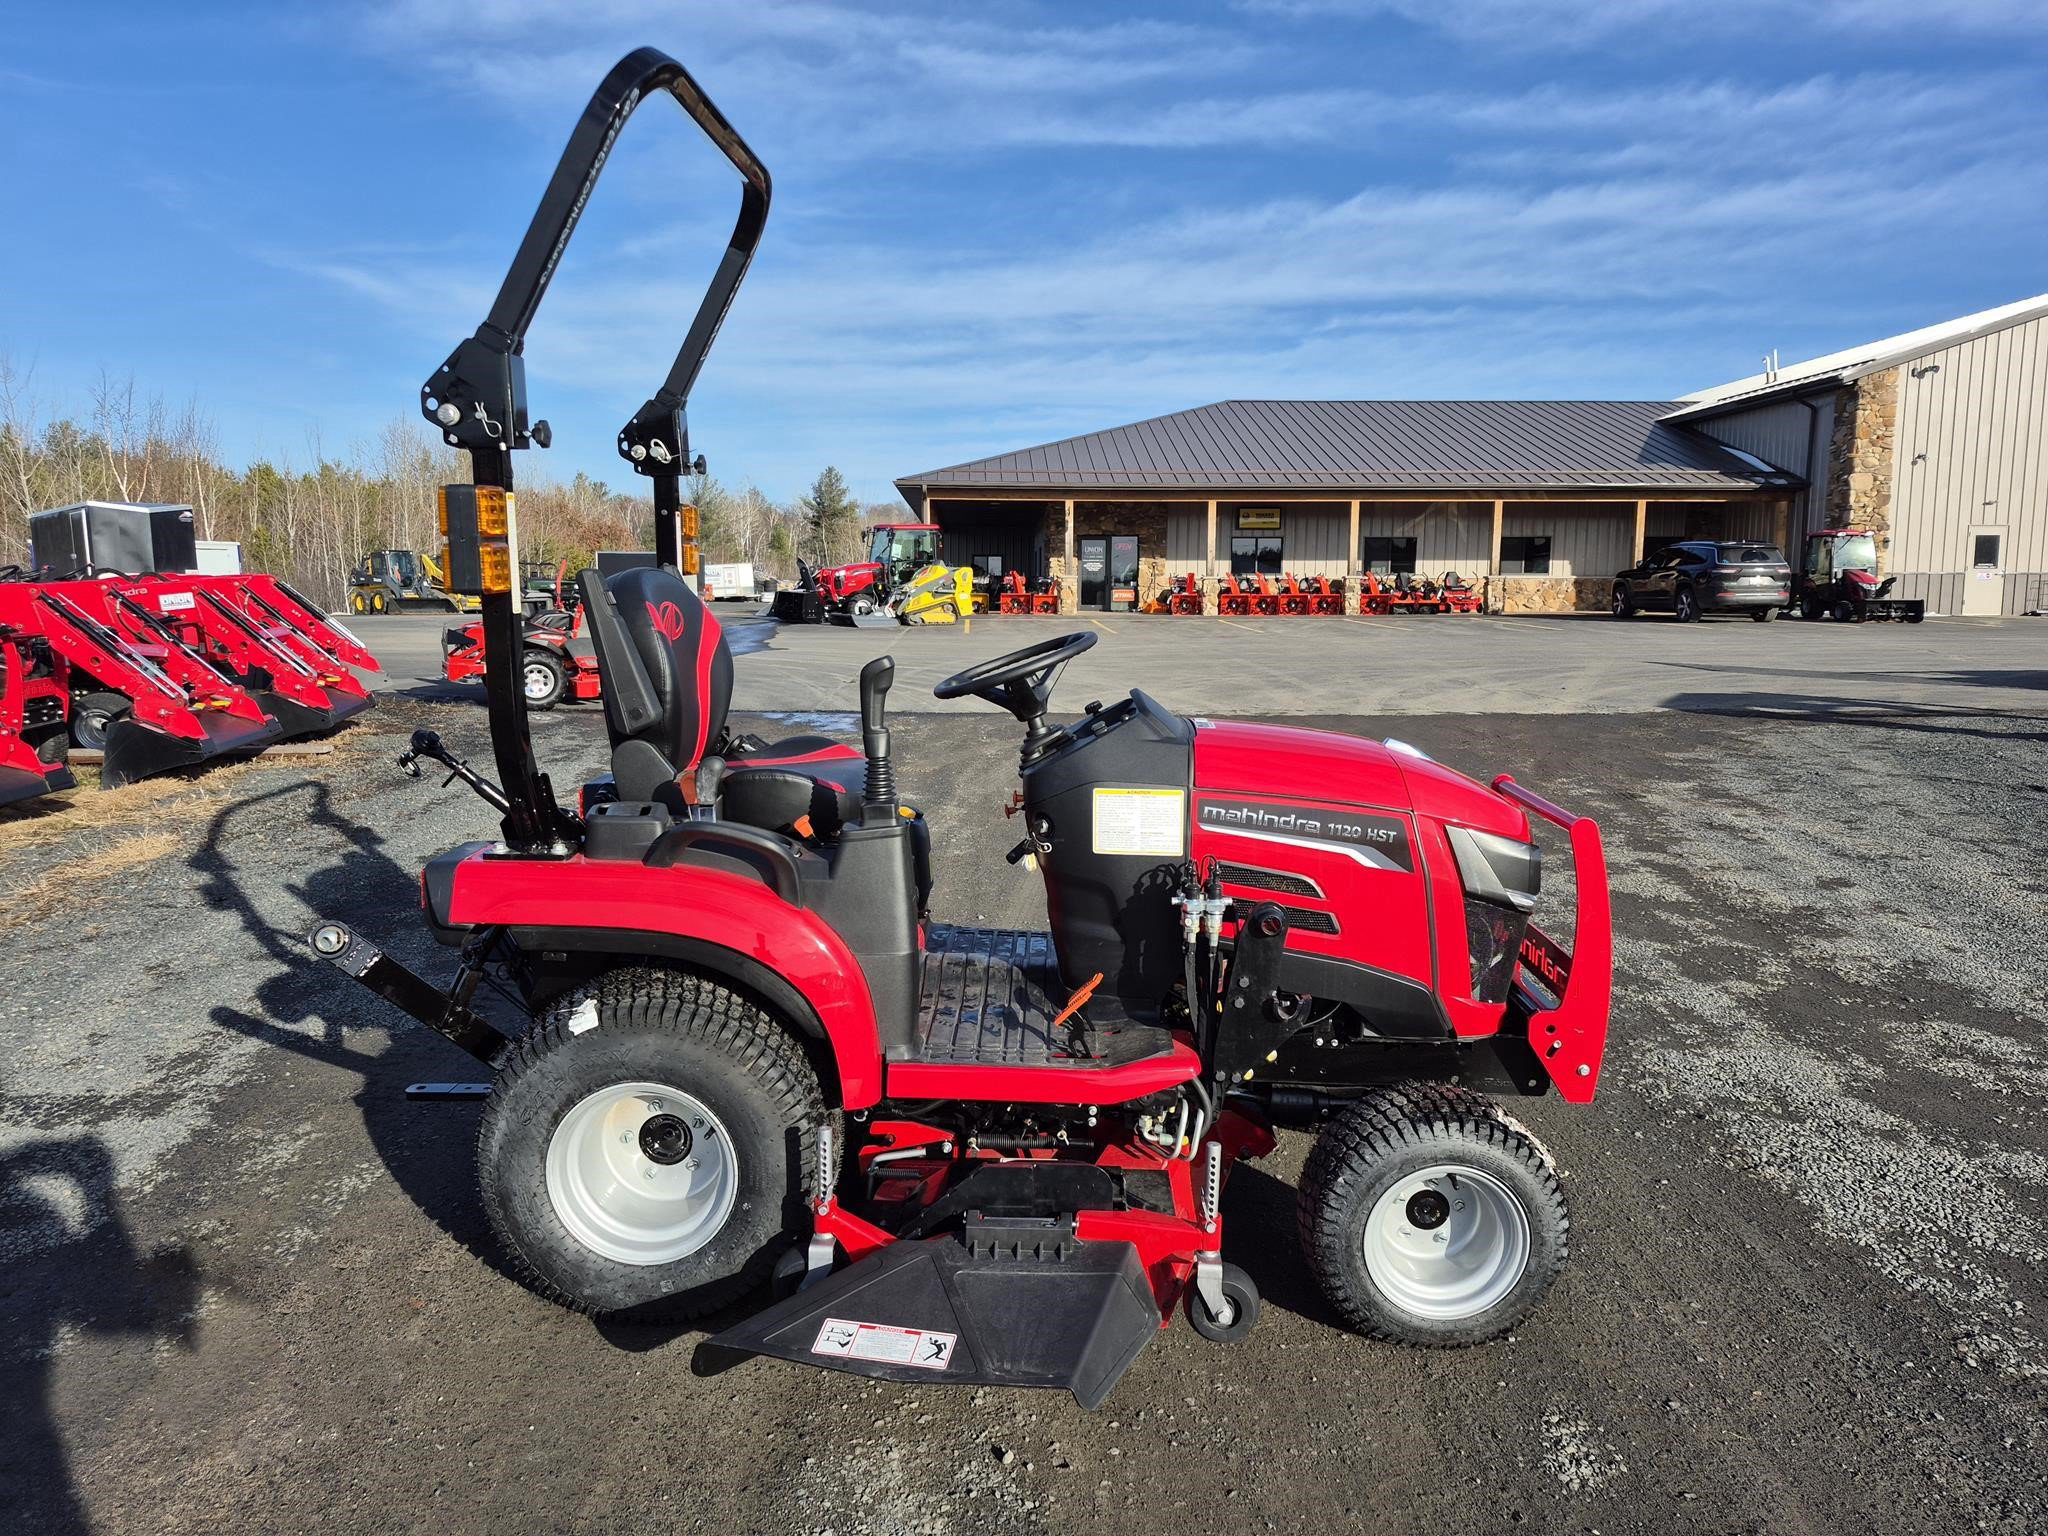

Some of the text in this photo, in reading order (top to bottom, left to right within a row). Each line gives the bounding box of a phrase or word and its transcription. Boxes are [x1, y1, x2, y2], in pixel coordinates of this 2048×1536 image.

[1203, 806, 1397, 843] mahindra 1120 HST
